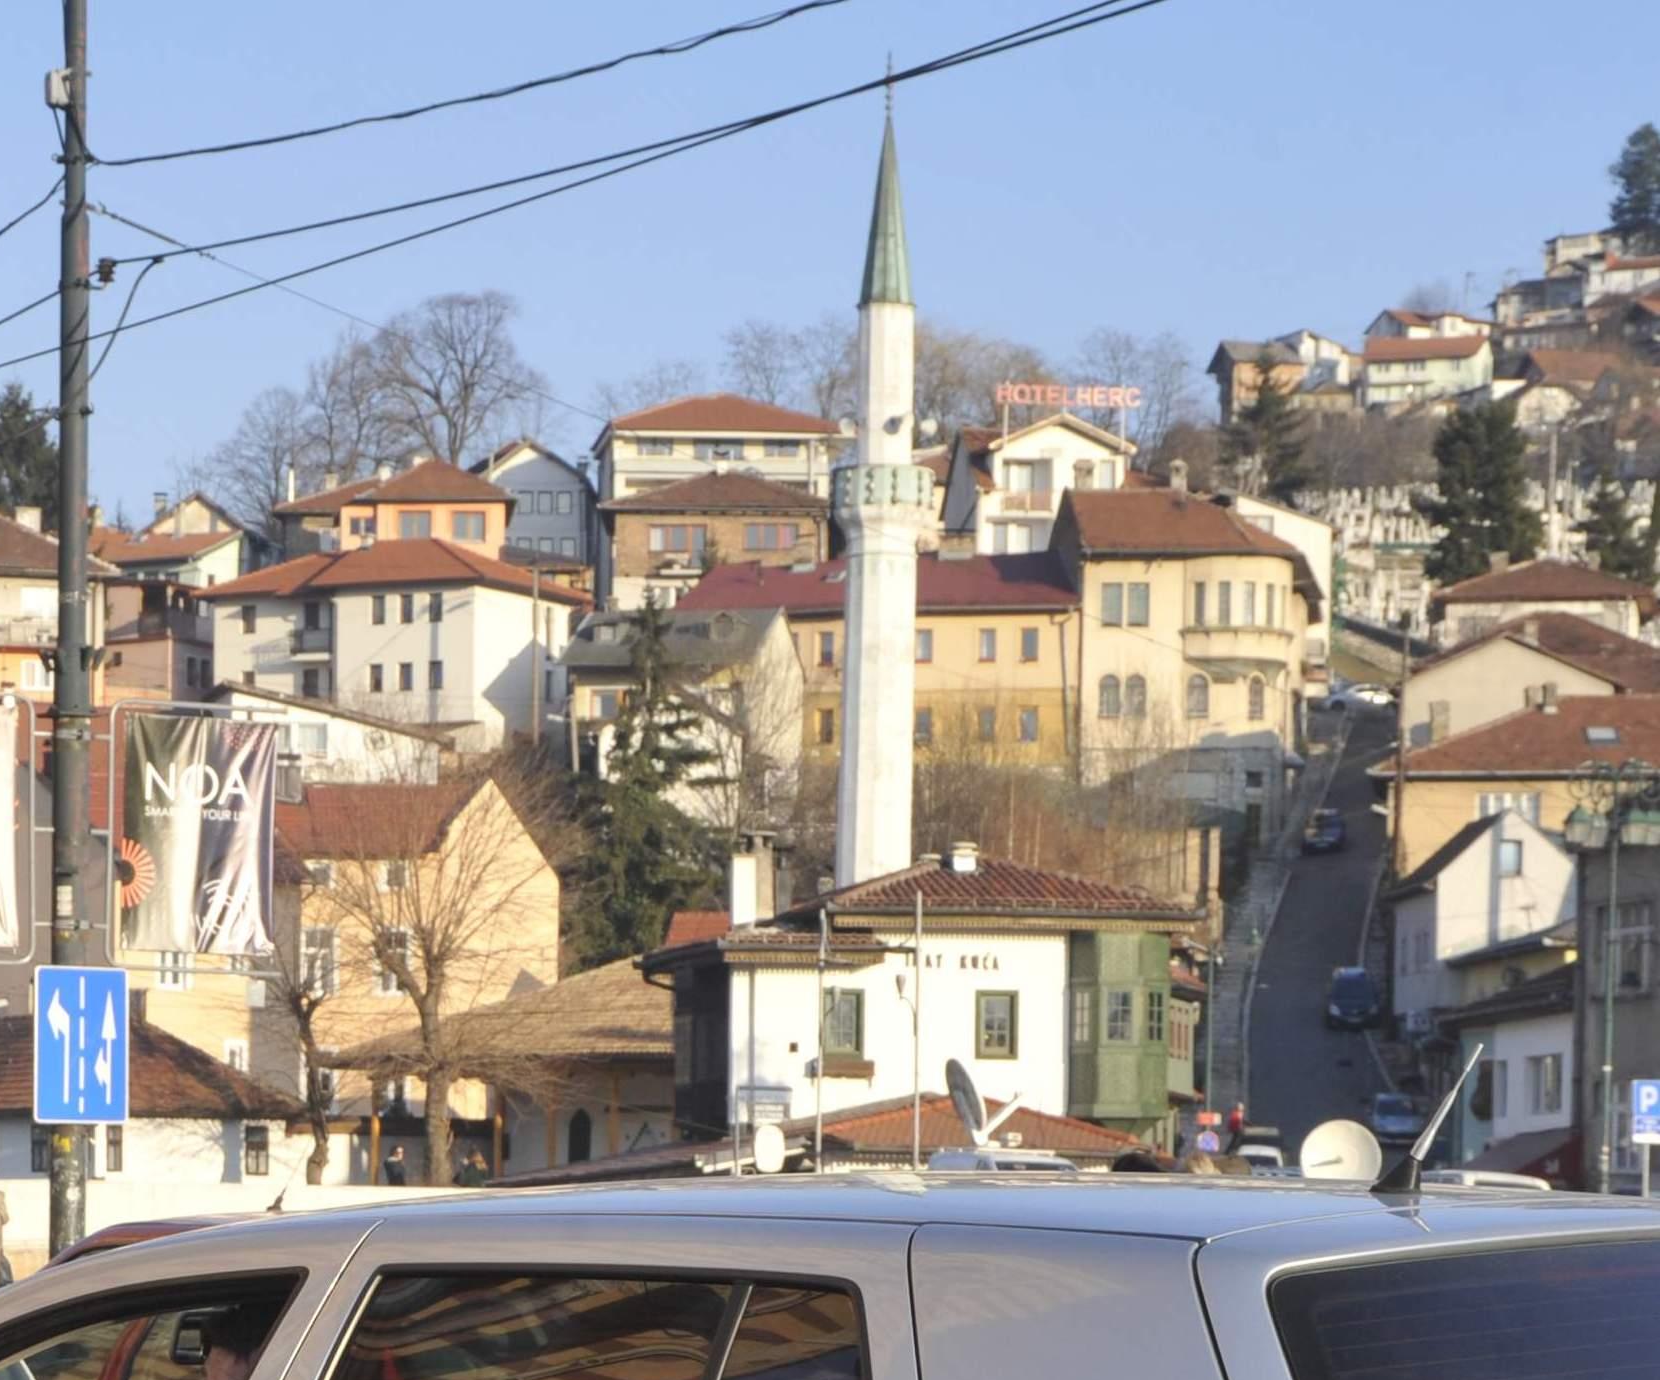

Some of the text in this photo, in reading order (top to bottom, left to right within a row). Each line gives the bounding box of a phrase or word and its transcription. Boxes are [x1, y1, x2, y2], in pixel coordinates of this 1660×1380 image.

[995, 384, 1076, 406] HOTEL
[144, 761, 254, 807] NOA
[1640, 1085, 1658, 1113] P
